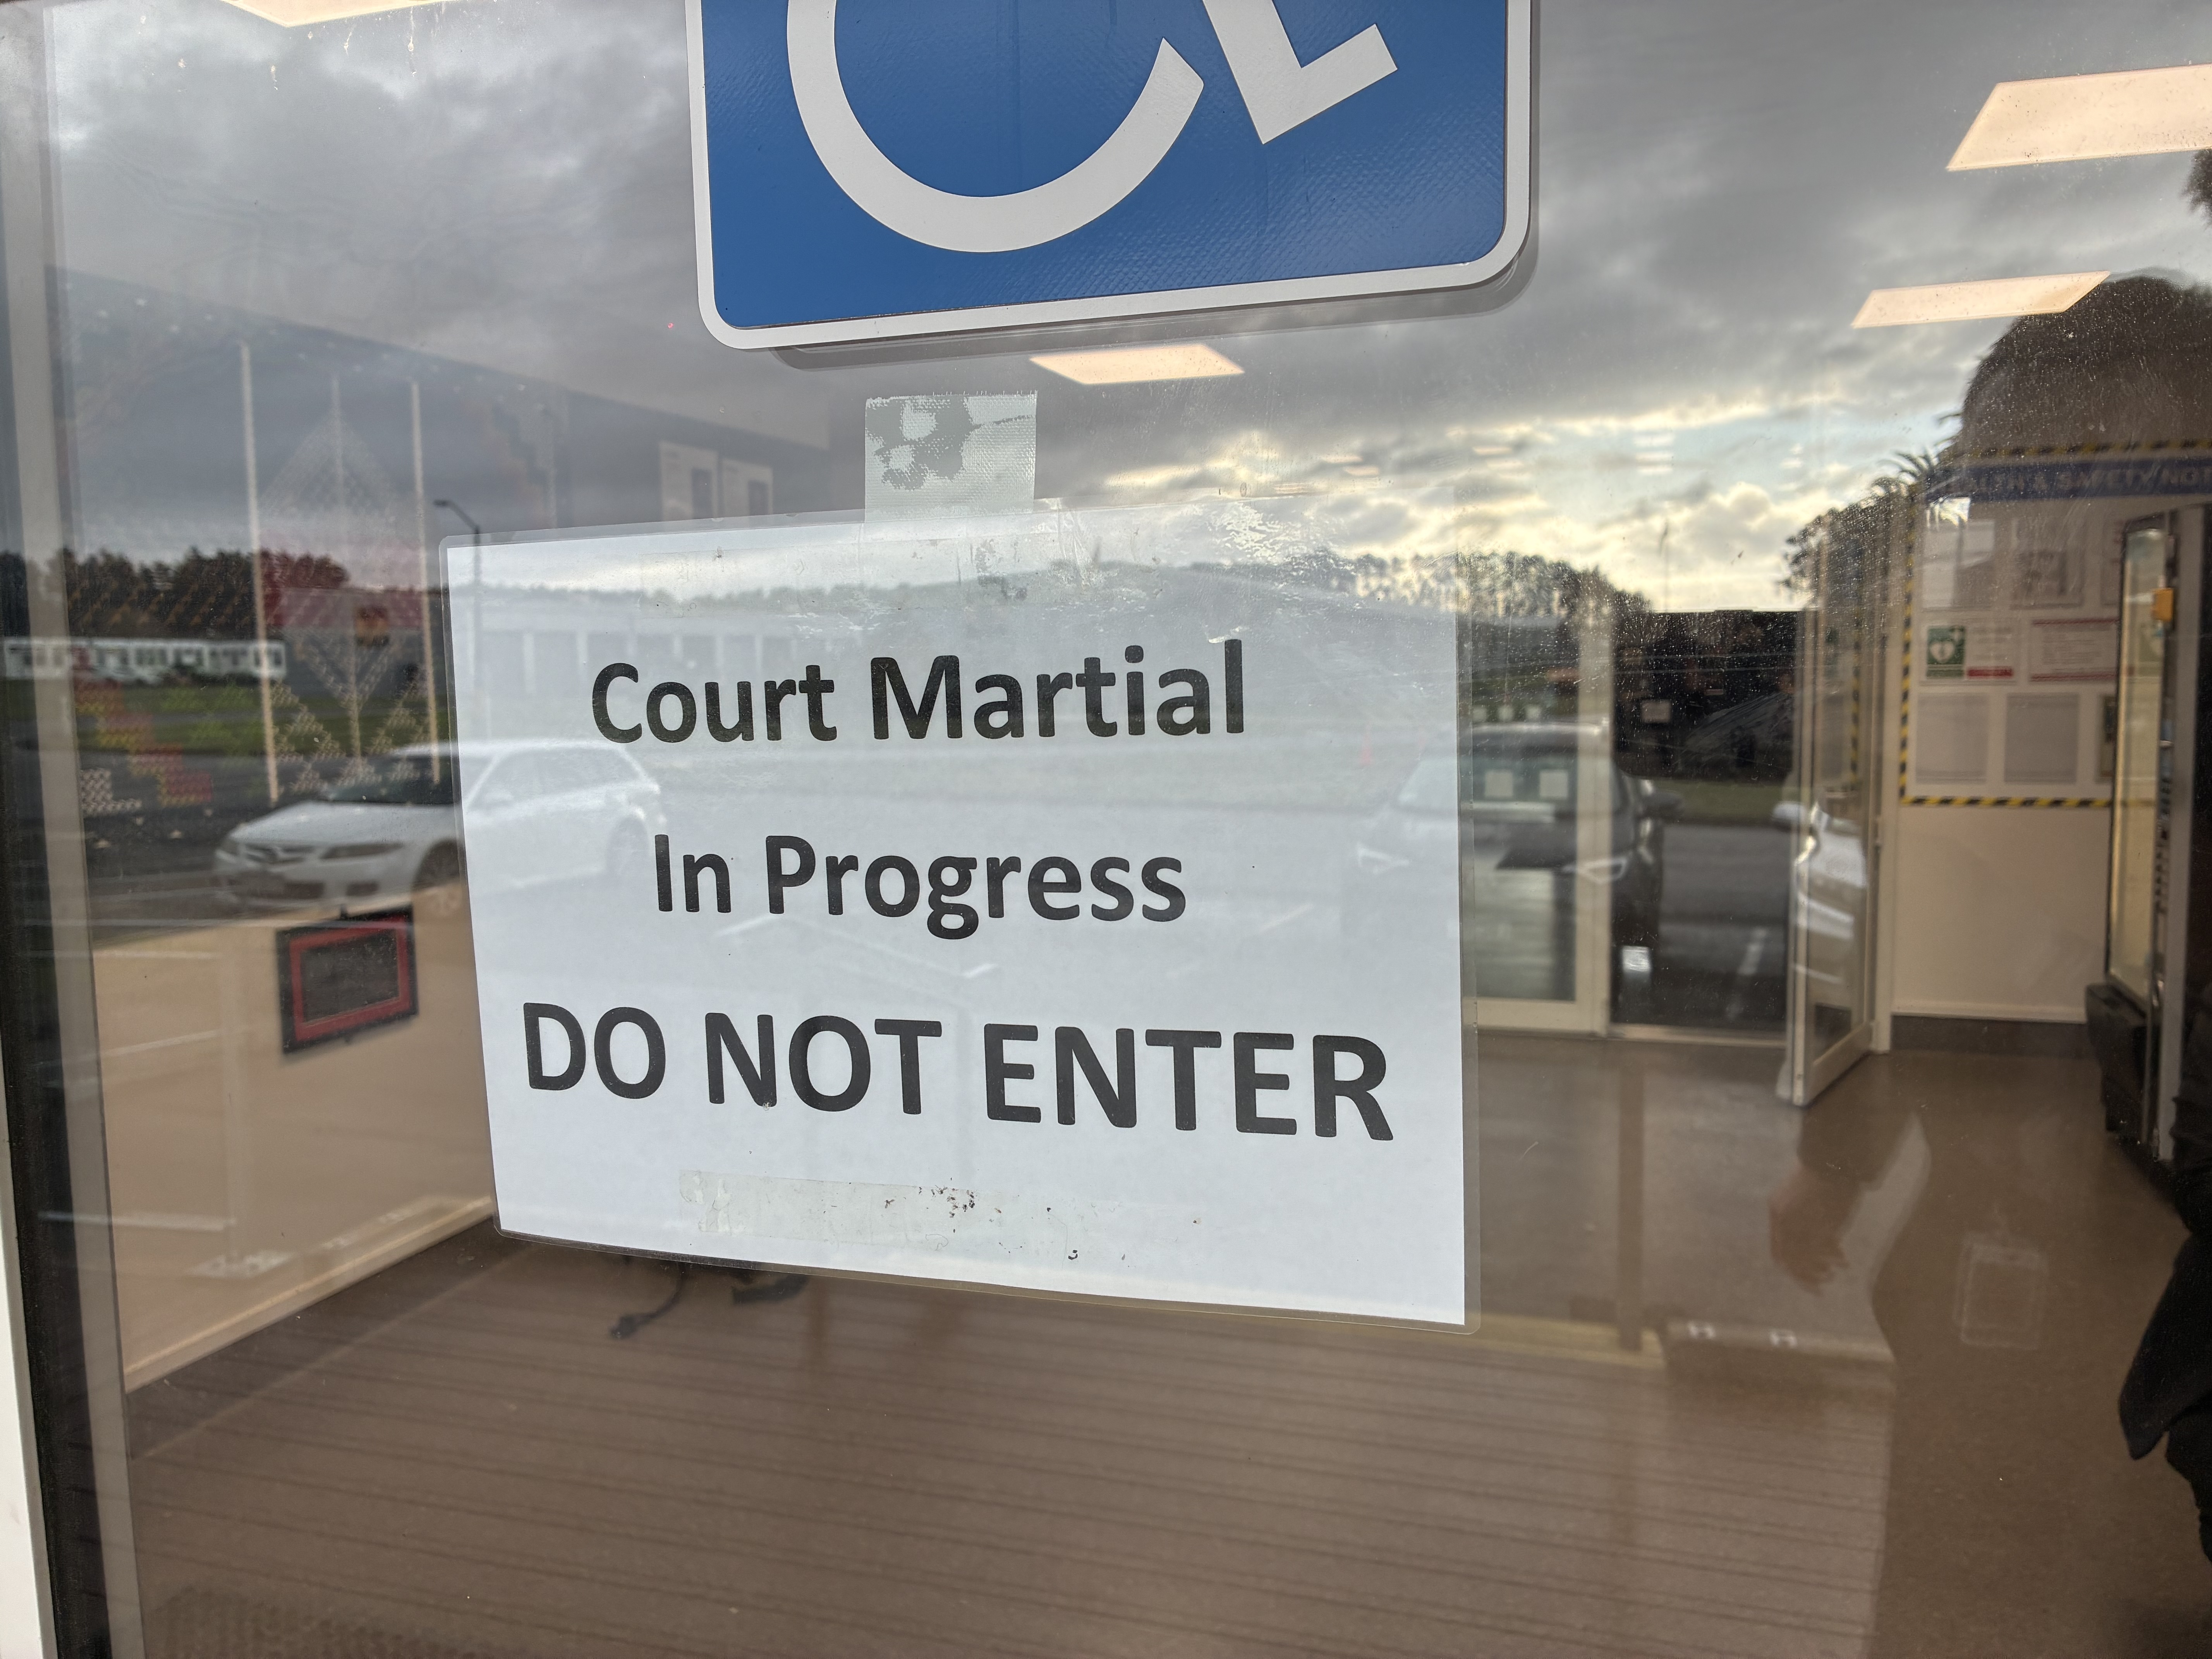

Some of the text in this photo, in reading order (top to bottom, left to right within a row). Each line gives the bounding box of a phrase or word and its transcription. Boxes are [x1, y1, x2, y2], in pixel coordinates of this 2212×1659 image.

[592, 639, 1244, 744] Court Martial
[654, 834, 1186, 940] In Progress
[523, 1002, 1394, 1141] DO NOT ENTER
